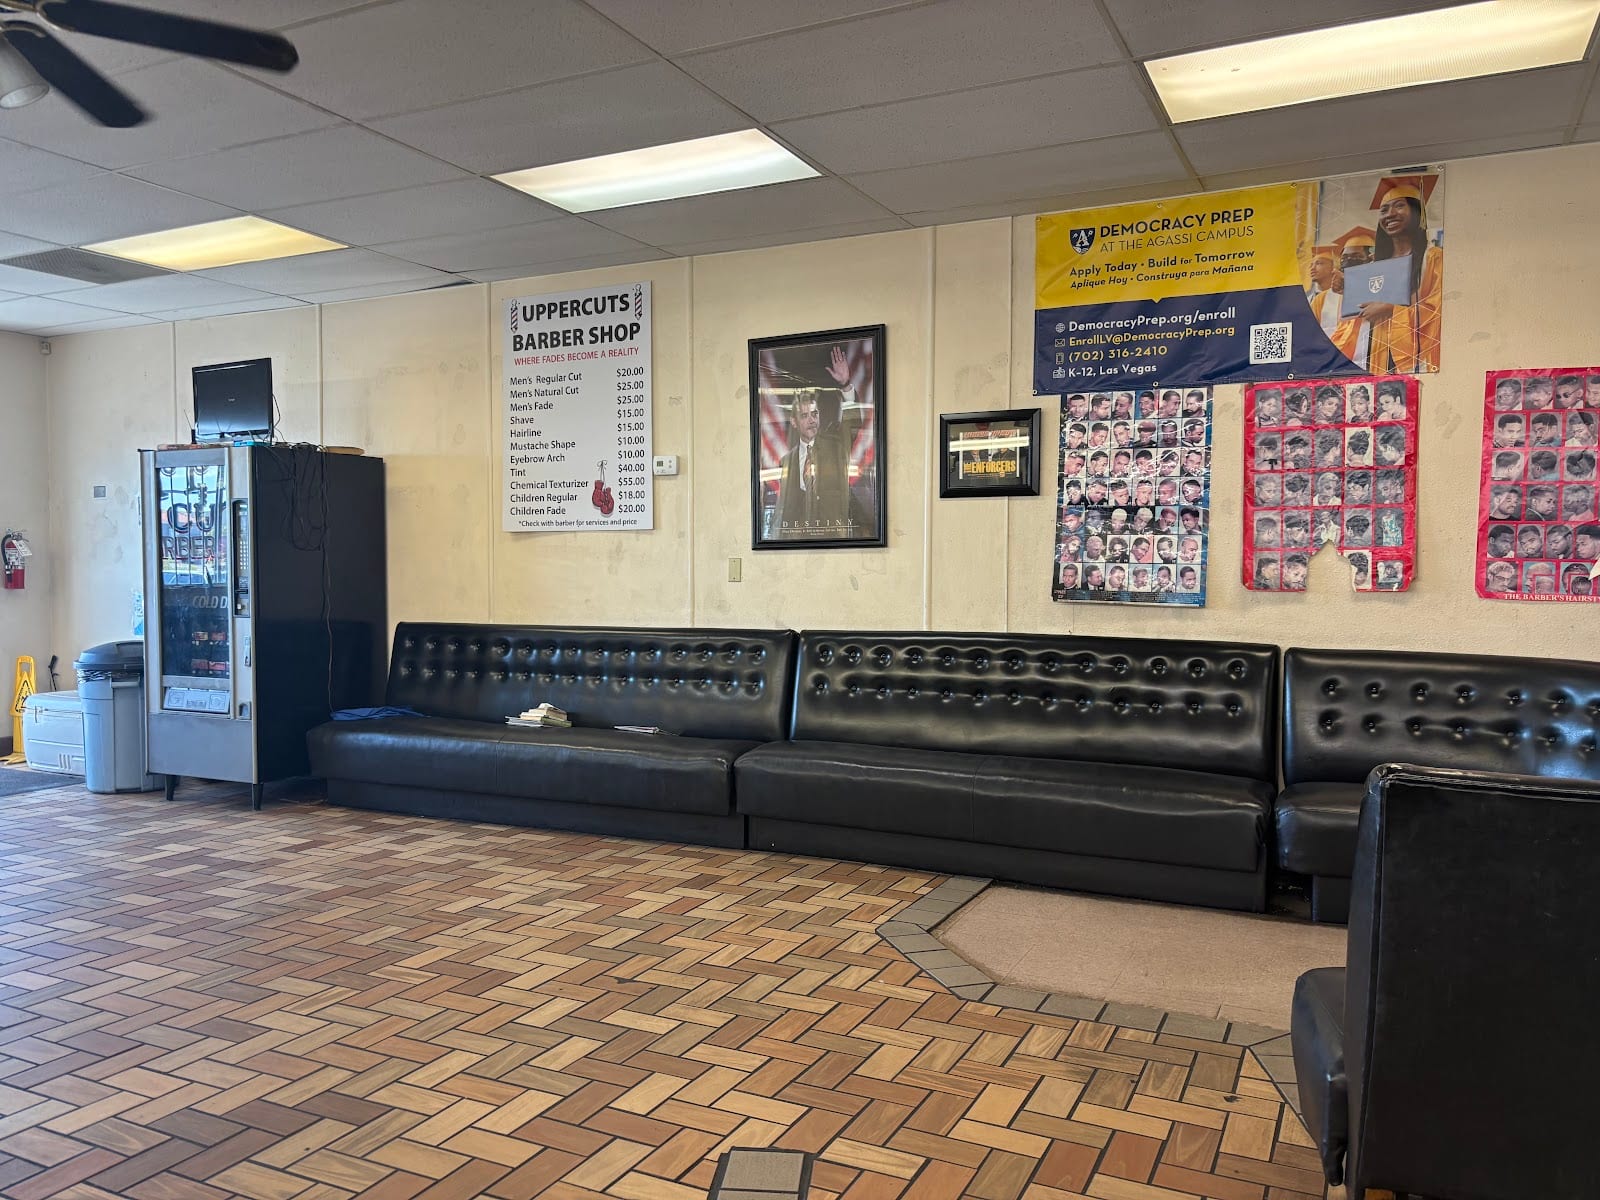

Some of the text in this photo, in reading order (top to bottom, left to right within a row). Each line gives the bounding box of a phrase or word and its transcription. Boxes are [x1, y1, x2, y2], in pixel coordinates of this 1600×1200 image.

[1100, 207, 1254, 238] DEMOCRACY PREP
[1100, 225, 1254, 253] AT THE AGASSI CAMPUS
[1069, 250, 1255, 279] Apply Today Build for Tomorrow
[1070, 263, 1254, 290] Aplique Hoy Construya para Mañana
[522, 293, 630, 322] UPPERCUTS
[1069, 307, 1236, 333] DemocracyPrep.org/enroll
[513, 322, 641, 352] BARBER SHOP
[1069, 325, 1235, 347] EnrollLV@DemocracyPrep.org
[514, 347, 639, 366] WHERE FADES BECOME A REALITY
[1068, 345, 1168, 364] (702) 316-2410
[616, 366, 644, 377] $20.00
[1068, 363, 1157, 378] K-12, Las Vegas
[510, 372, 582, 386] Men's Regular Cut
[616, 380, 644, 391] $25.00
[510, 386, 579, 399] Men's Natural Cut
[617, 395, 644, 405] $25.00
[510, 401, 554, 411] Men's Fade
[617, 408, 644, 419] $15.00
[510, 416, 534, 425] Shave
[617, 422, 644, 432] $15.00
[510, 428, 542, 438] Hairline
[510, 440, 576, 451] Mustache Shape
[617, 436, 645, 445] $10.00
[510, 453, 566, 465] Eyebrow Arch
[618, 449, 645, 459] $10.00
[510, 468, 526, 477] Tint
[618, 463, 645, 473] $40.00
[971, 460, 1016, 474] ENFORCERS
[510, 479, 589, 490] Chemical Texturizer
[618, 477, 645, 486] $55.00
[510, 493, 578, 503] Children Regular
[618, 490, 646, 500] $18.00
[510, 506, 566, 516] Children Fade
[618, 504, 646, 513] $20.00
[555, 519, 575, 527] barber
[575, 519, 585, 527] for
[782, 518, 854, 528] DESTINY
[192, 595, 219, 609] COLD
